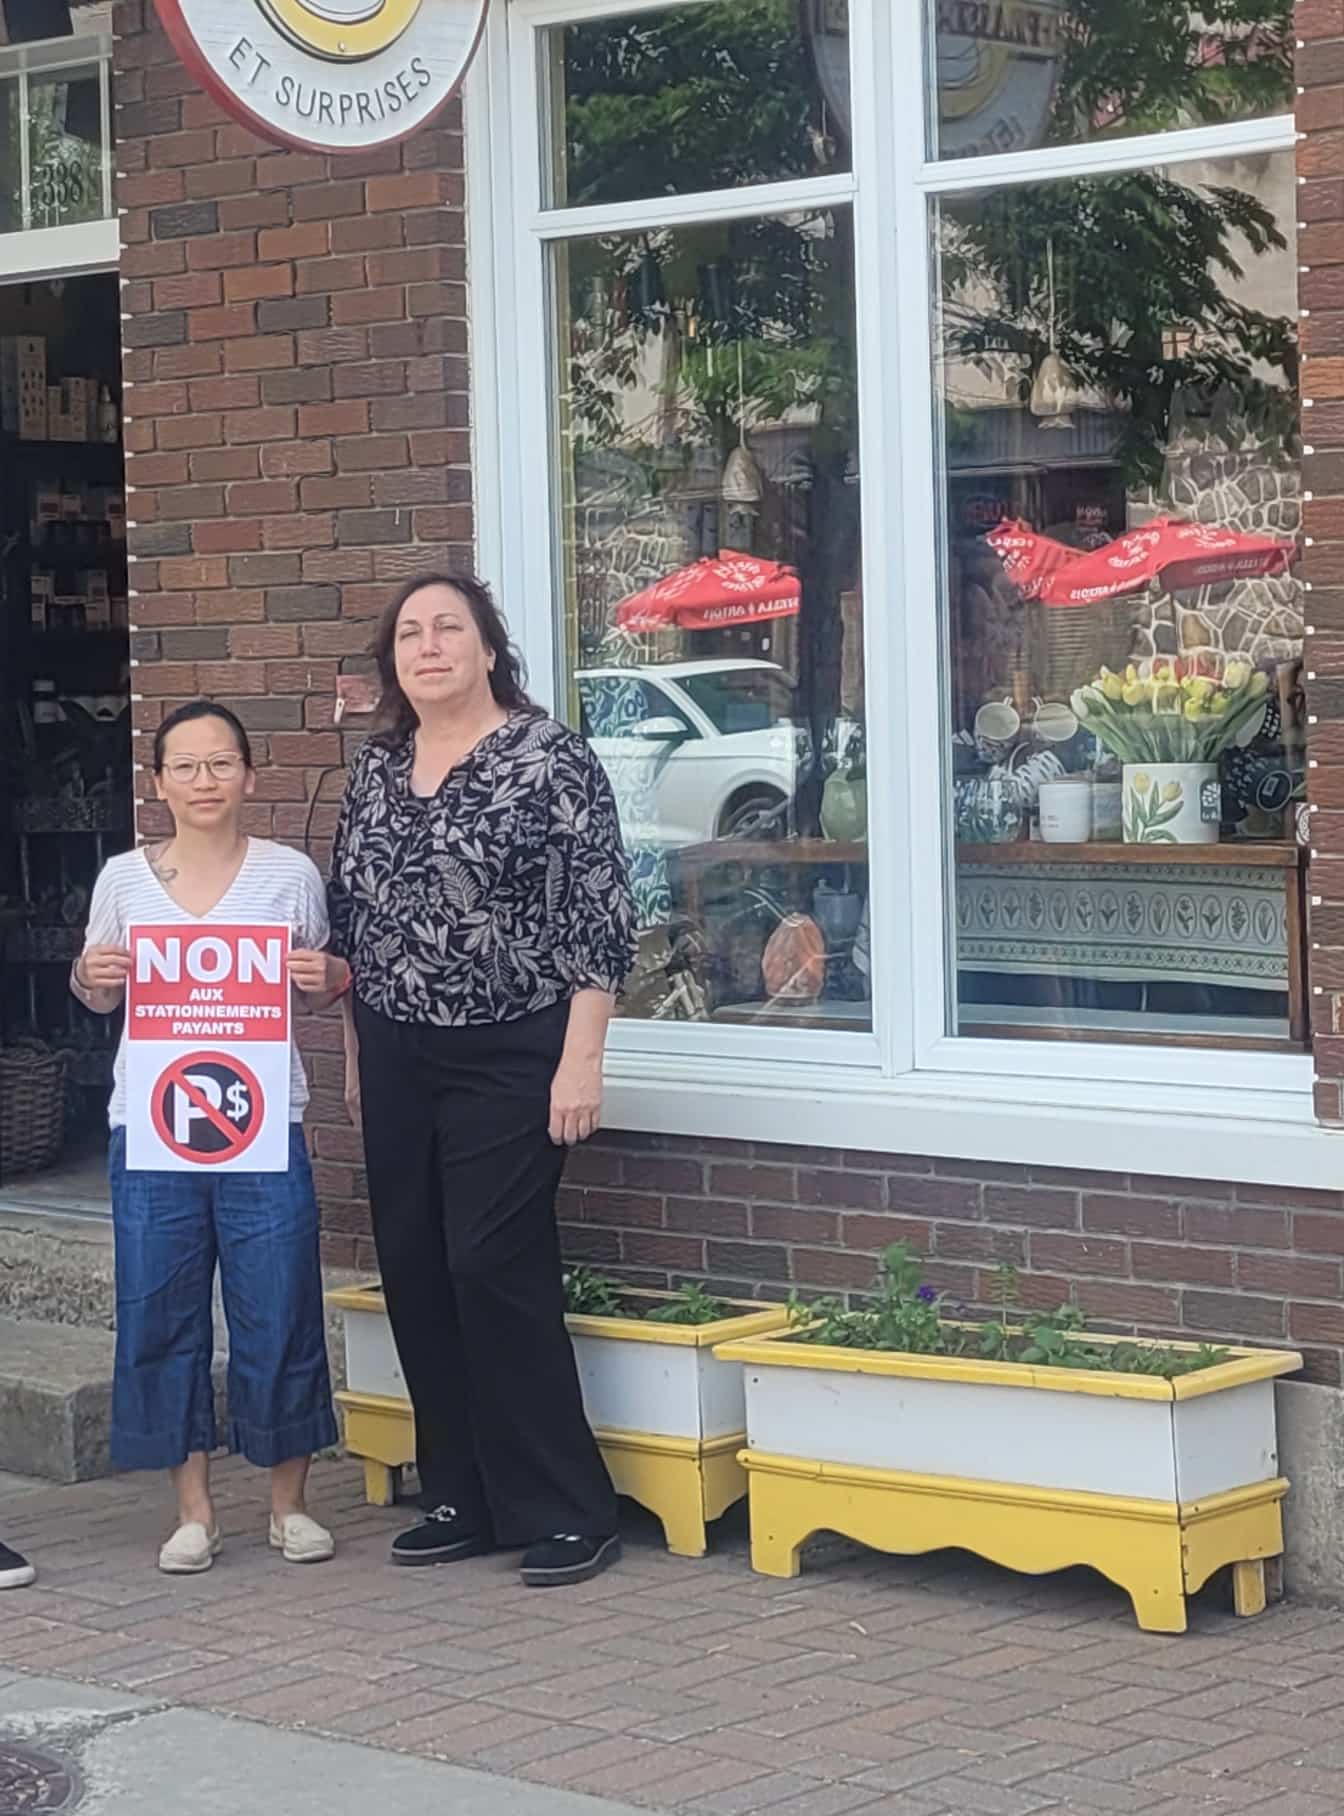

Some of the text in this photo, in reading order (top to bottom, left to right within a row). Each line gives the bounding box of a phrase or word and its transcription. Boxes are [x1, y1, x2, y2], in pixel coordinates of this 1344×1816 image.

[228, 36, 432, 126] ET SURPRISES
[136, 937, 282, 984] NON
[189, 988, 224, 1002] AUX
[135, 1005, 282, 1019] STATIONNEMENTS
[172, 1021, 245, 1035] PAYANTS
